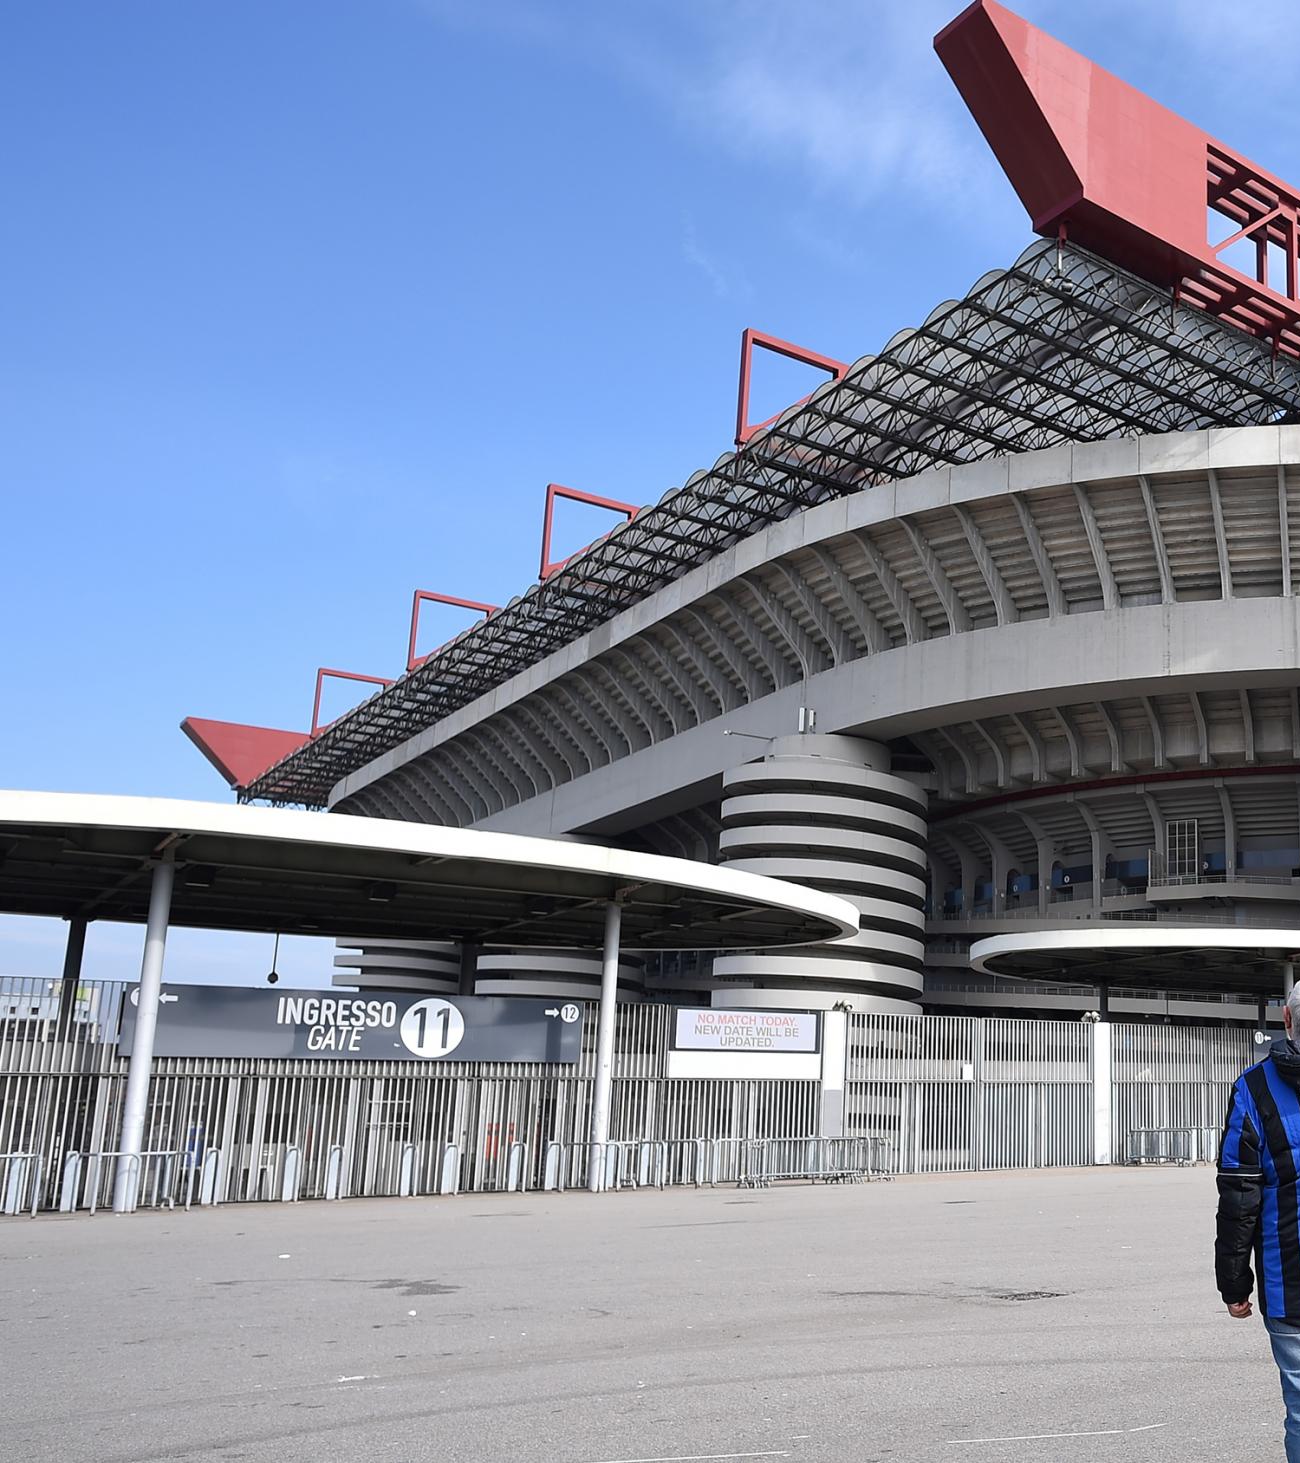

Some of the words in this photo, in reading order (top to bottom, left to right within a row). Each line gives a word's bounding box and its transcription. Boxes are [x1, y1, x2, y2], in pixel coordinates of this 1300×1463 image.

[277, 997, 397, 1028] INGRESSO
[563, 1006, 577, 1020] 12
[413, 1006, 451, 1049] 11
[697, 1014, 715, 1025] NO
[718, 1015, 757, 1026] MATCH
[760, 1016, 798, 1027] TODAY.
[307, 1026, 365, 1051] GATE
[694, 1025, 721, 1035] NEW
[724, 1026, 753, 1036] DATE
[756, 1027, 781, 1037] WILL
[785, 1028, 799, 1038] BE
[720, 1037, 775, 1048] UPDATED.
